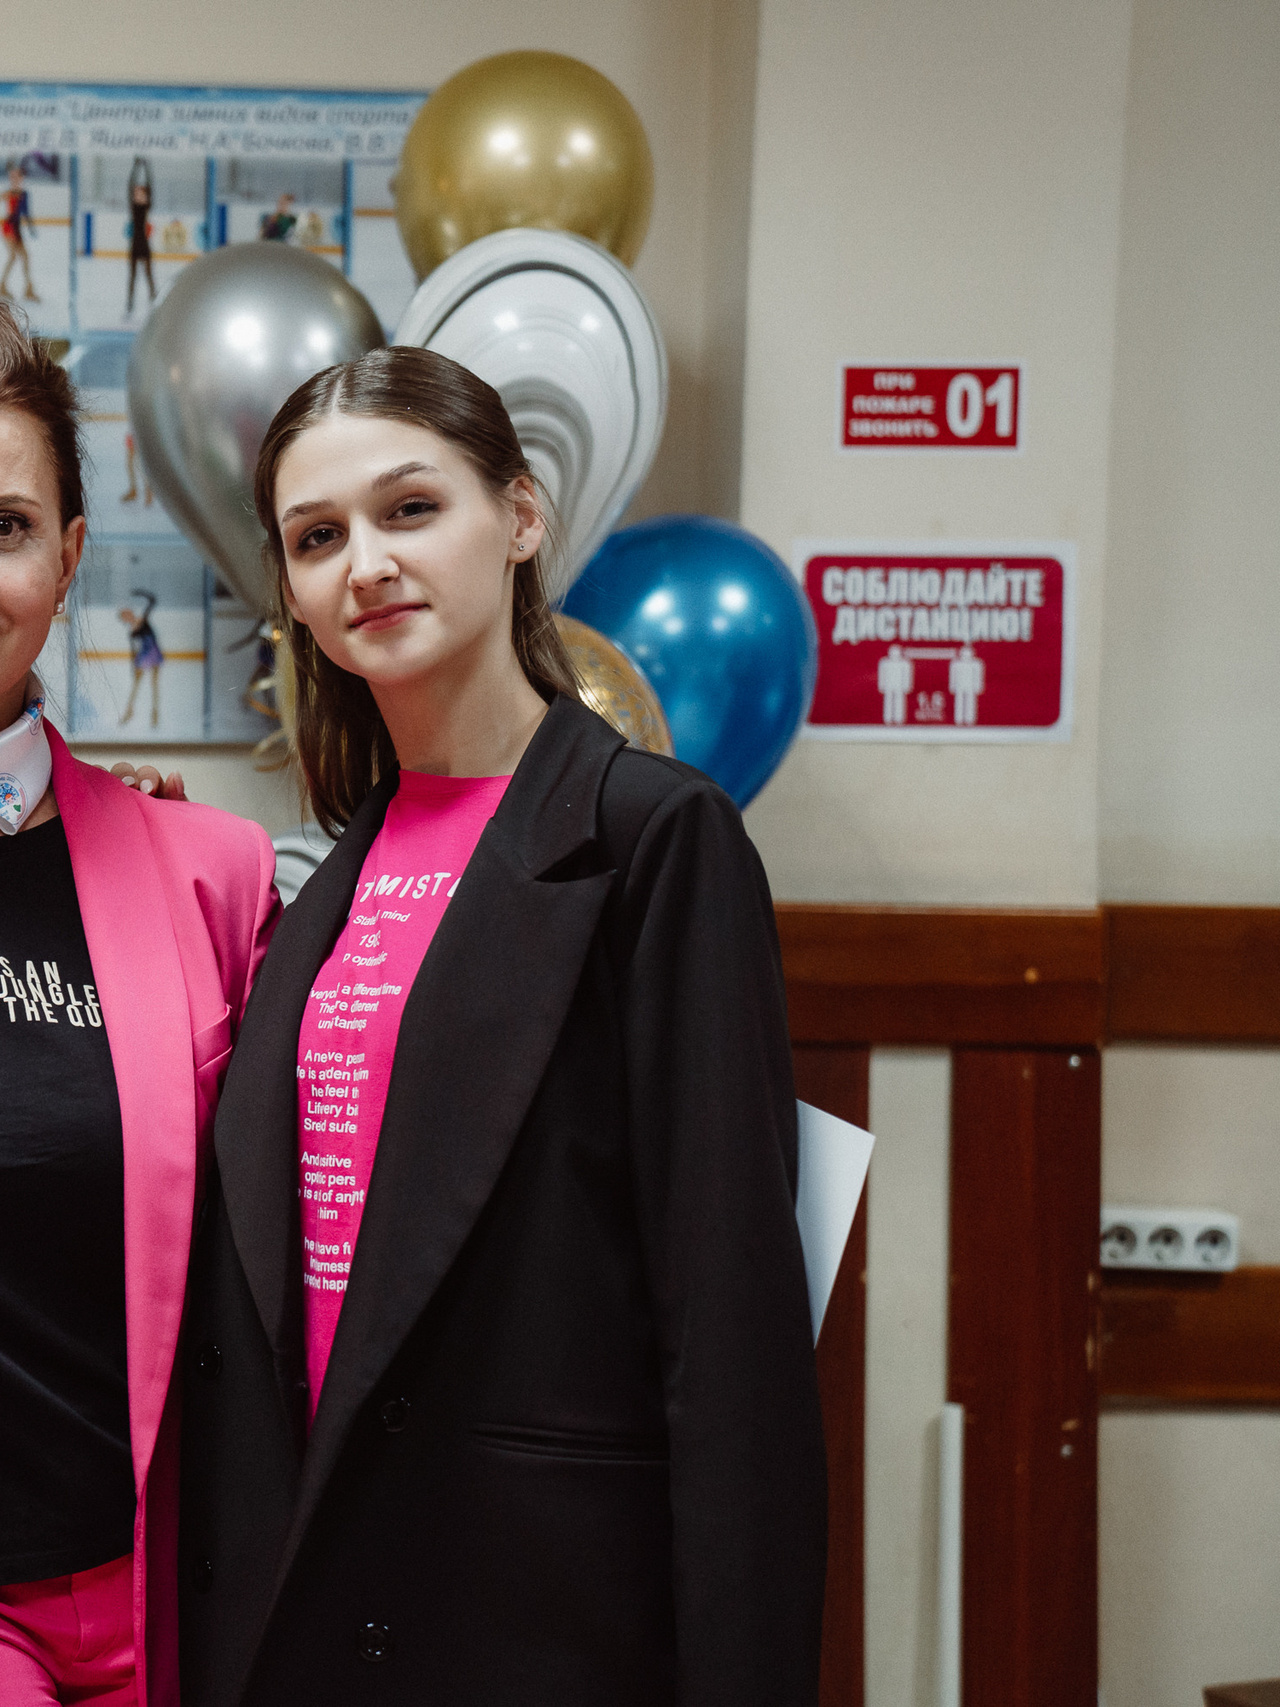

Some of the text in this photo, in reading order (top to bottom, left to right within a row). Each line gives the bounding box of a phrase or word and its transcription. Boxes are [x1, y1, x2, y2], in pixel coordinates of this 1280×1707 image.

[852, 395, 936, 415] ПОЖАРЕ
[946, 372, 1015, 439] 01
[848, 418, 939, 438] ЗВОНИТЬ
[822, 561, 1044, 609] СОБЛЮДАЙТЕ
[832, 605, 1034, 646] ДИСТАНЦИЮ!
[381, 910, 411, 923] mind
[25, 960, 62, 985] AN
[3, 996, 59, 1023] THE
